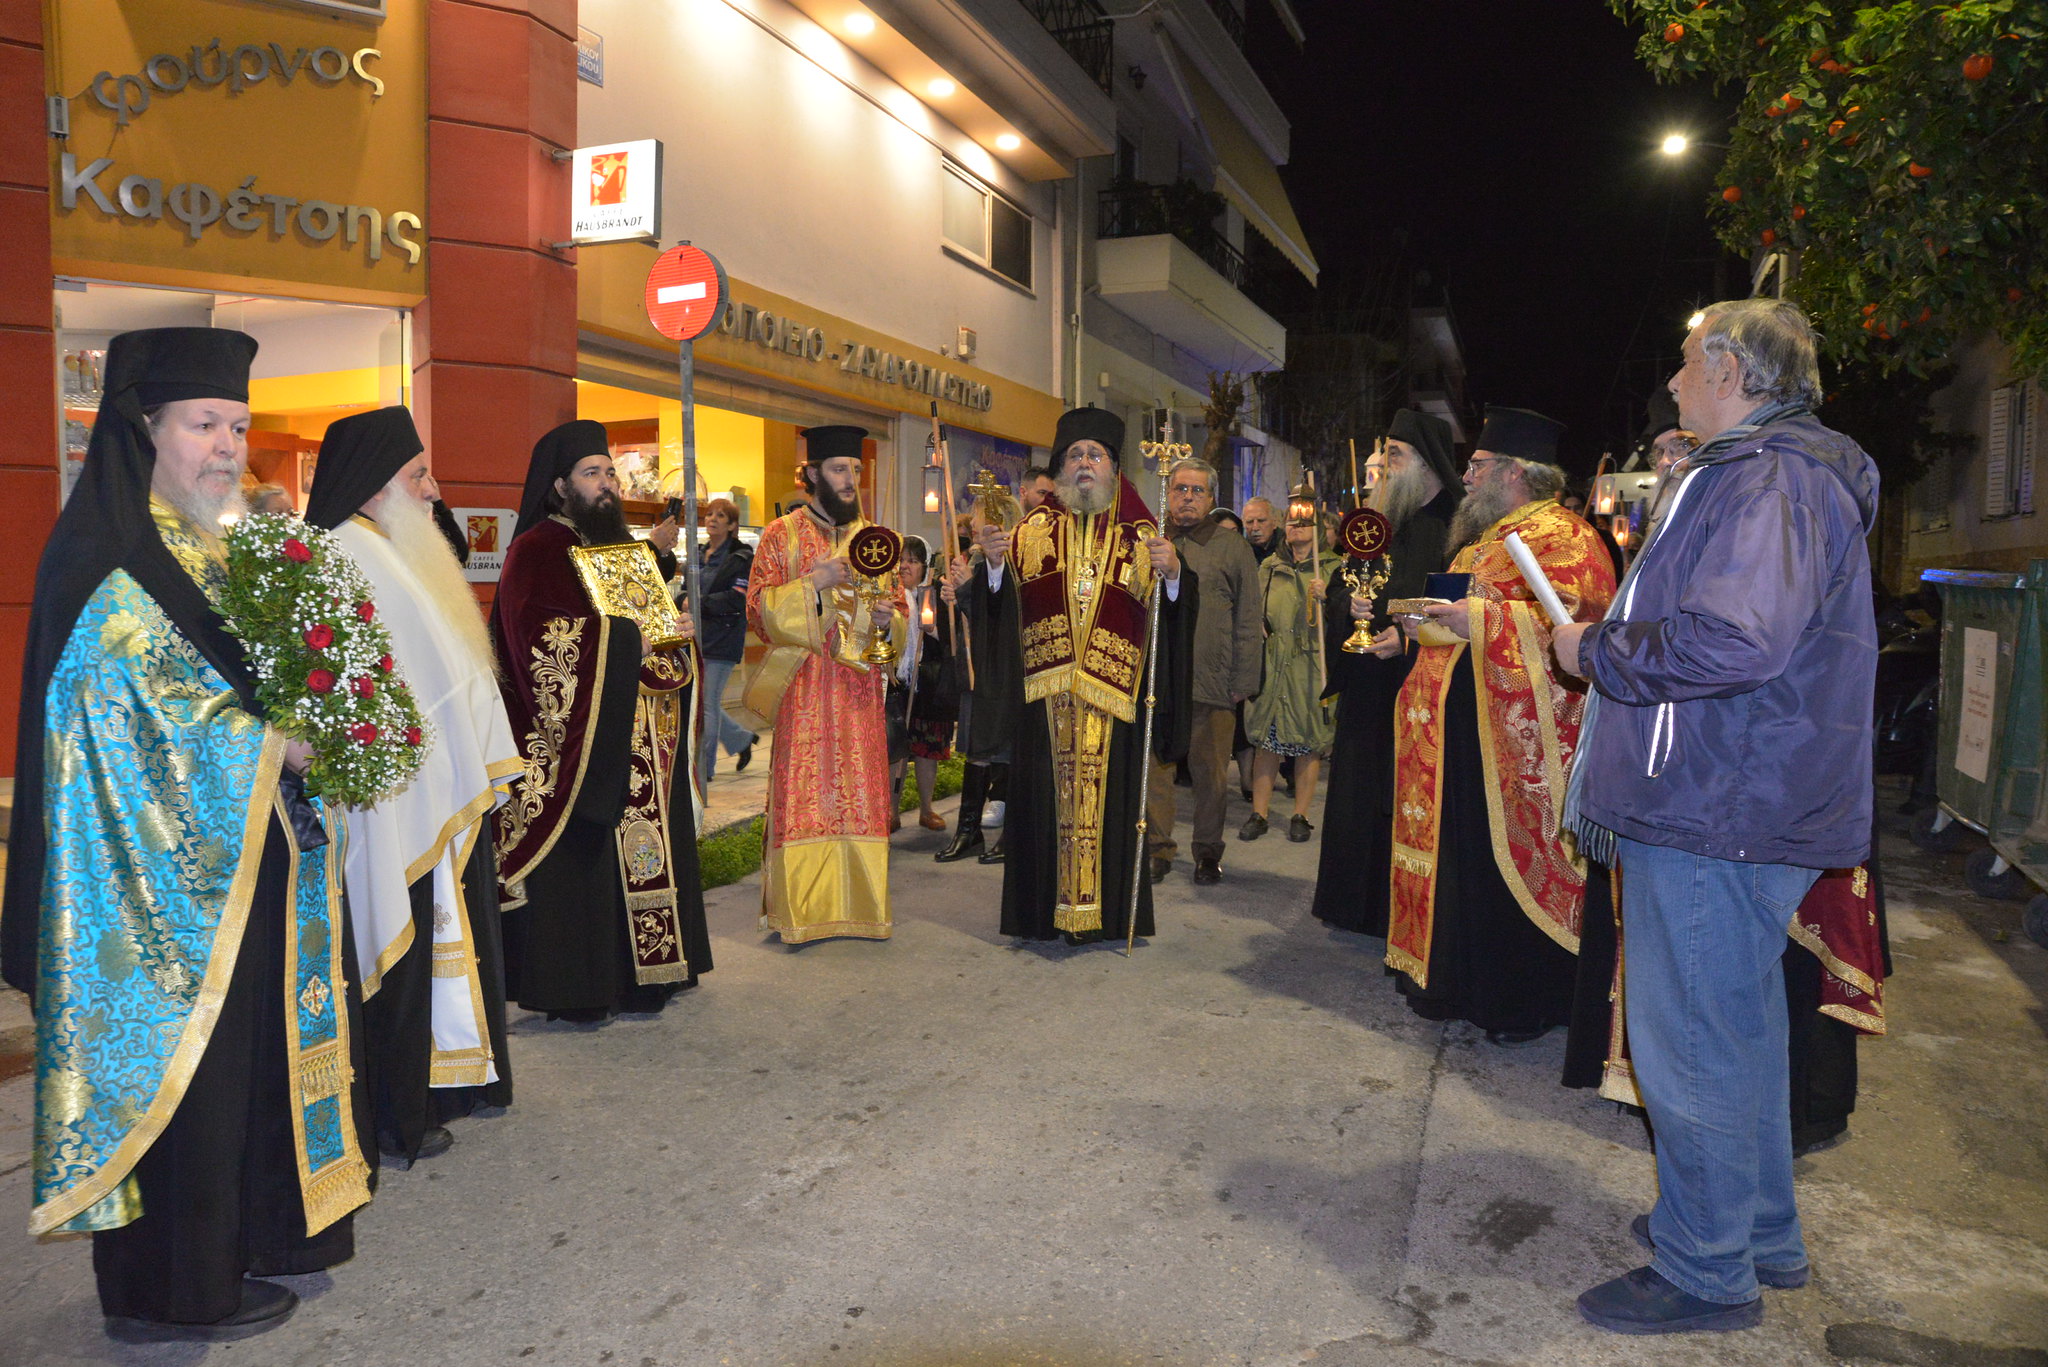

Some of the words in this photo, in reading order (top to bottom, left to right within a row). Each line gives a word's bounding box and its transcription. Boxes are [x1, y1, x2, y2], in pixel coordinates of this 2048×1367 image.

[92, 38, 384, 126] φούρνος
[61, 153, 422, 265] Καφέτσης
[575, 216, 643, 232] HAUSBRANDT
